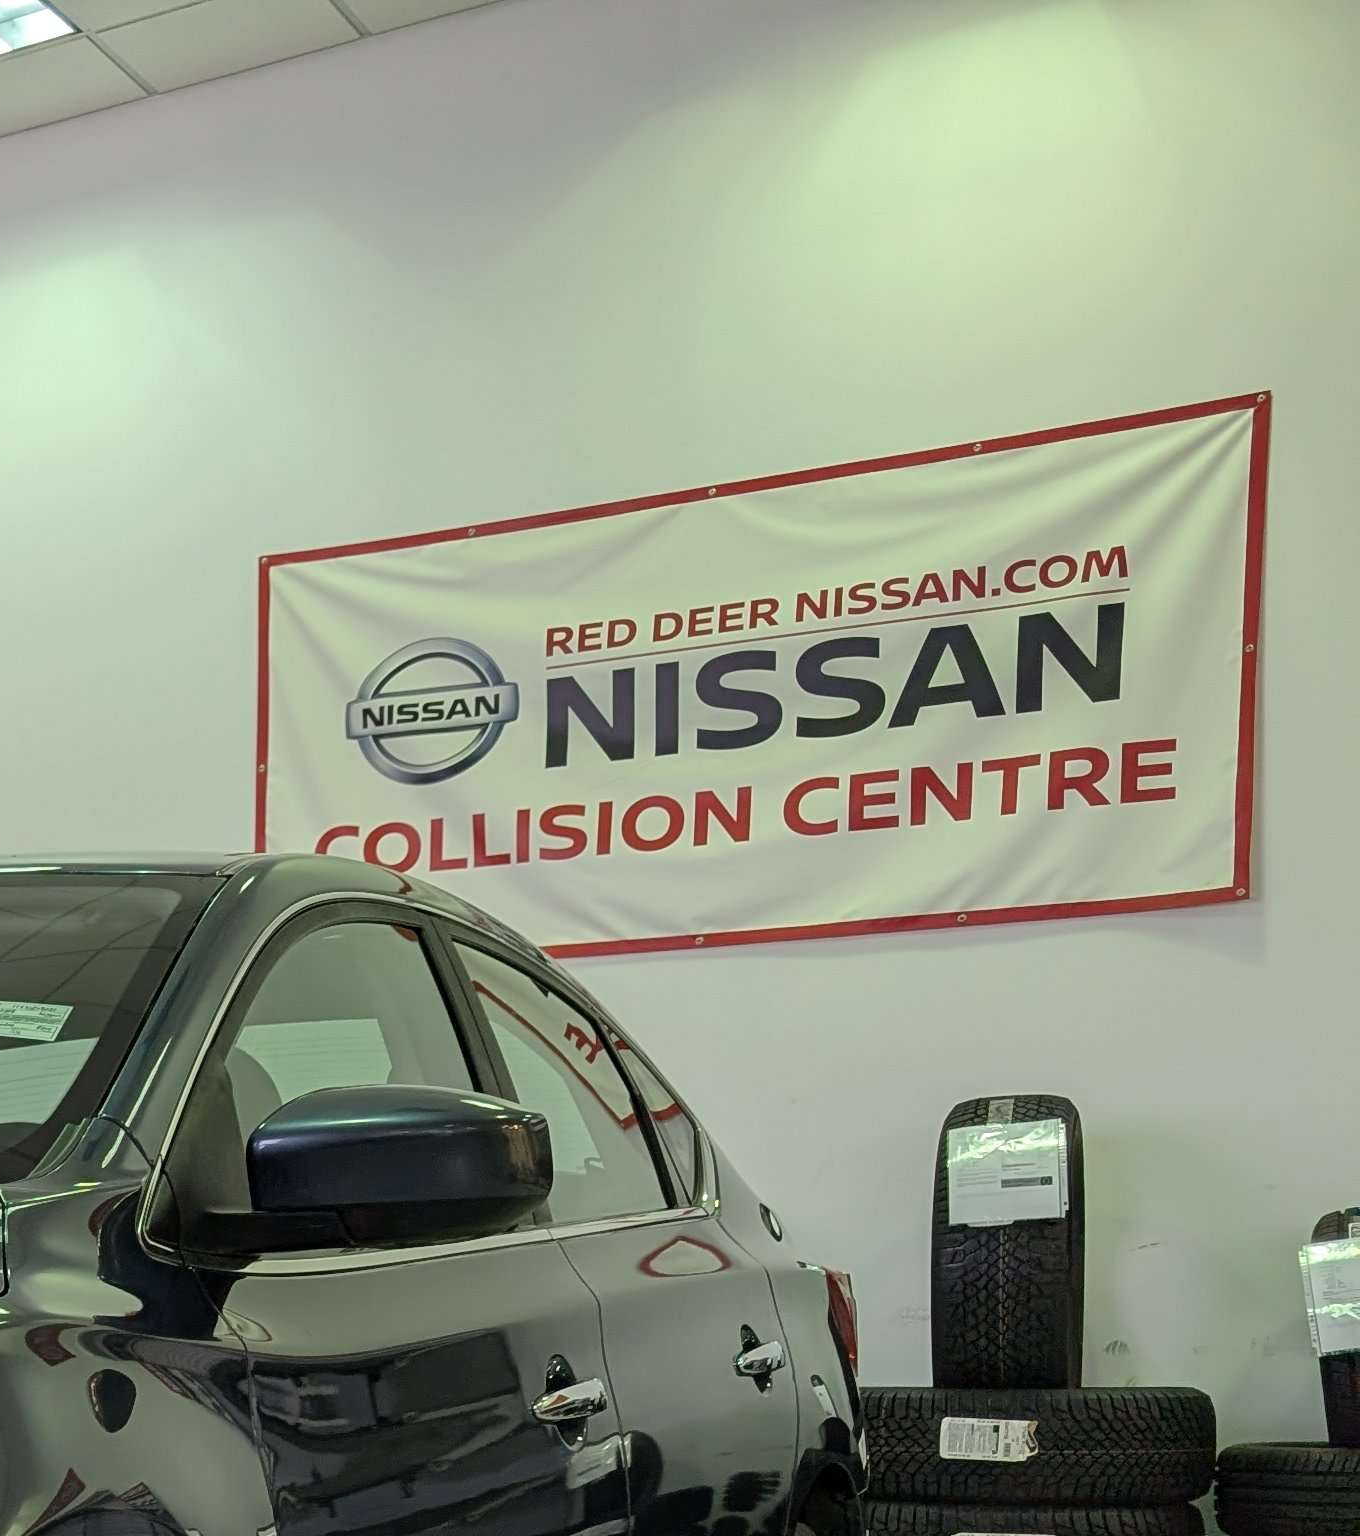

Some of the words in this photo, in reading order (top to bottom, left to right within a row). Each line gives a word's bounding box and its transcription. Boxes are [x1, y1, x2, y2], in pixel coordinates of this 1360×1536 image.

[545, 623, 638, 657] RED
[651, 598, 779, 642] DEER
[794, 545, 1129, 621] NISSAN.COM
[361, 693, 502, 730] NISSAN
[544, 601, 1126, 770] NISSAN
[783, 738, 1178, 838] CENTRE
